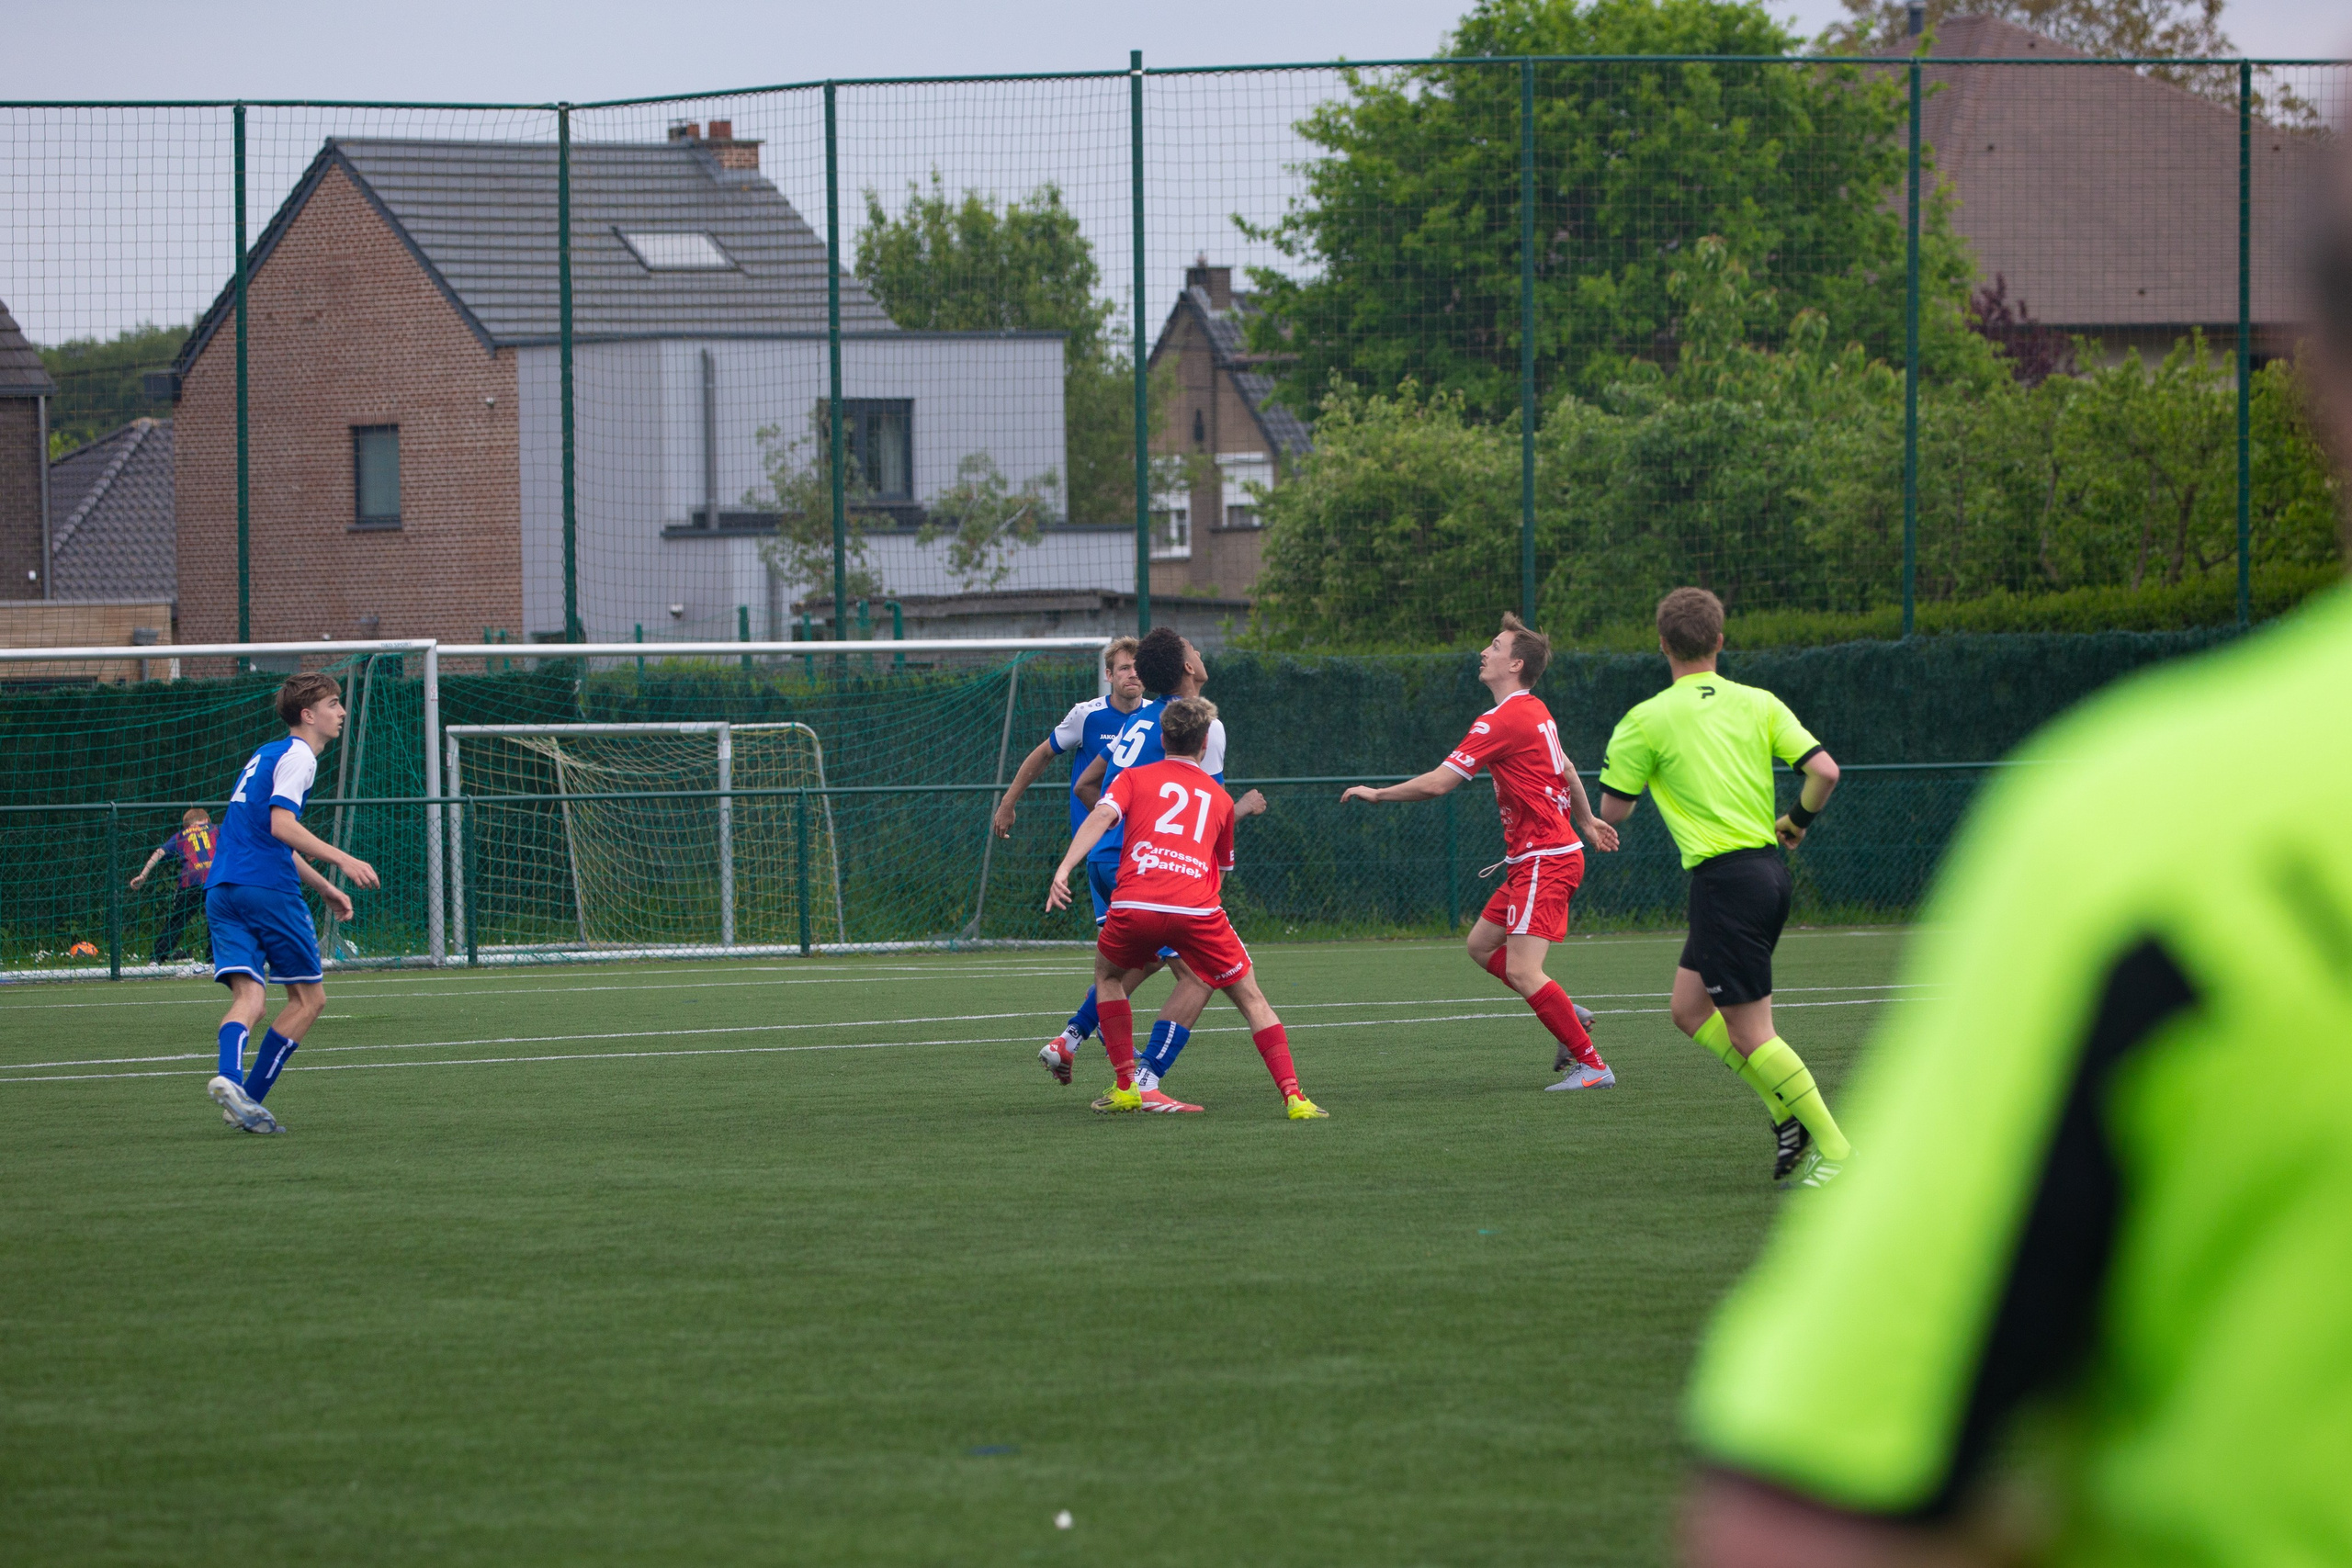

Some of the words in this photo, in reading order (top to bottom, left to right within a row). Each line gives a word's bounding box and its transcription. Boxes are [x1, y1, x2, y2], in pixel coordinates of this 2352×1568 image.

[1113, 719, 1155, 768] 5
[1537, 719, 1565, 775] 10
[230, 753, 262, 803] 2
[1154, 782, 1212, 844] 21
[187, 830, 211, 852] 11
[1506, 904, 1517, 927] 0
[1220, 960, 1244, 979] PATRICK
